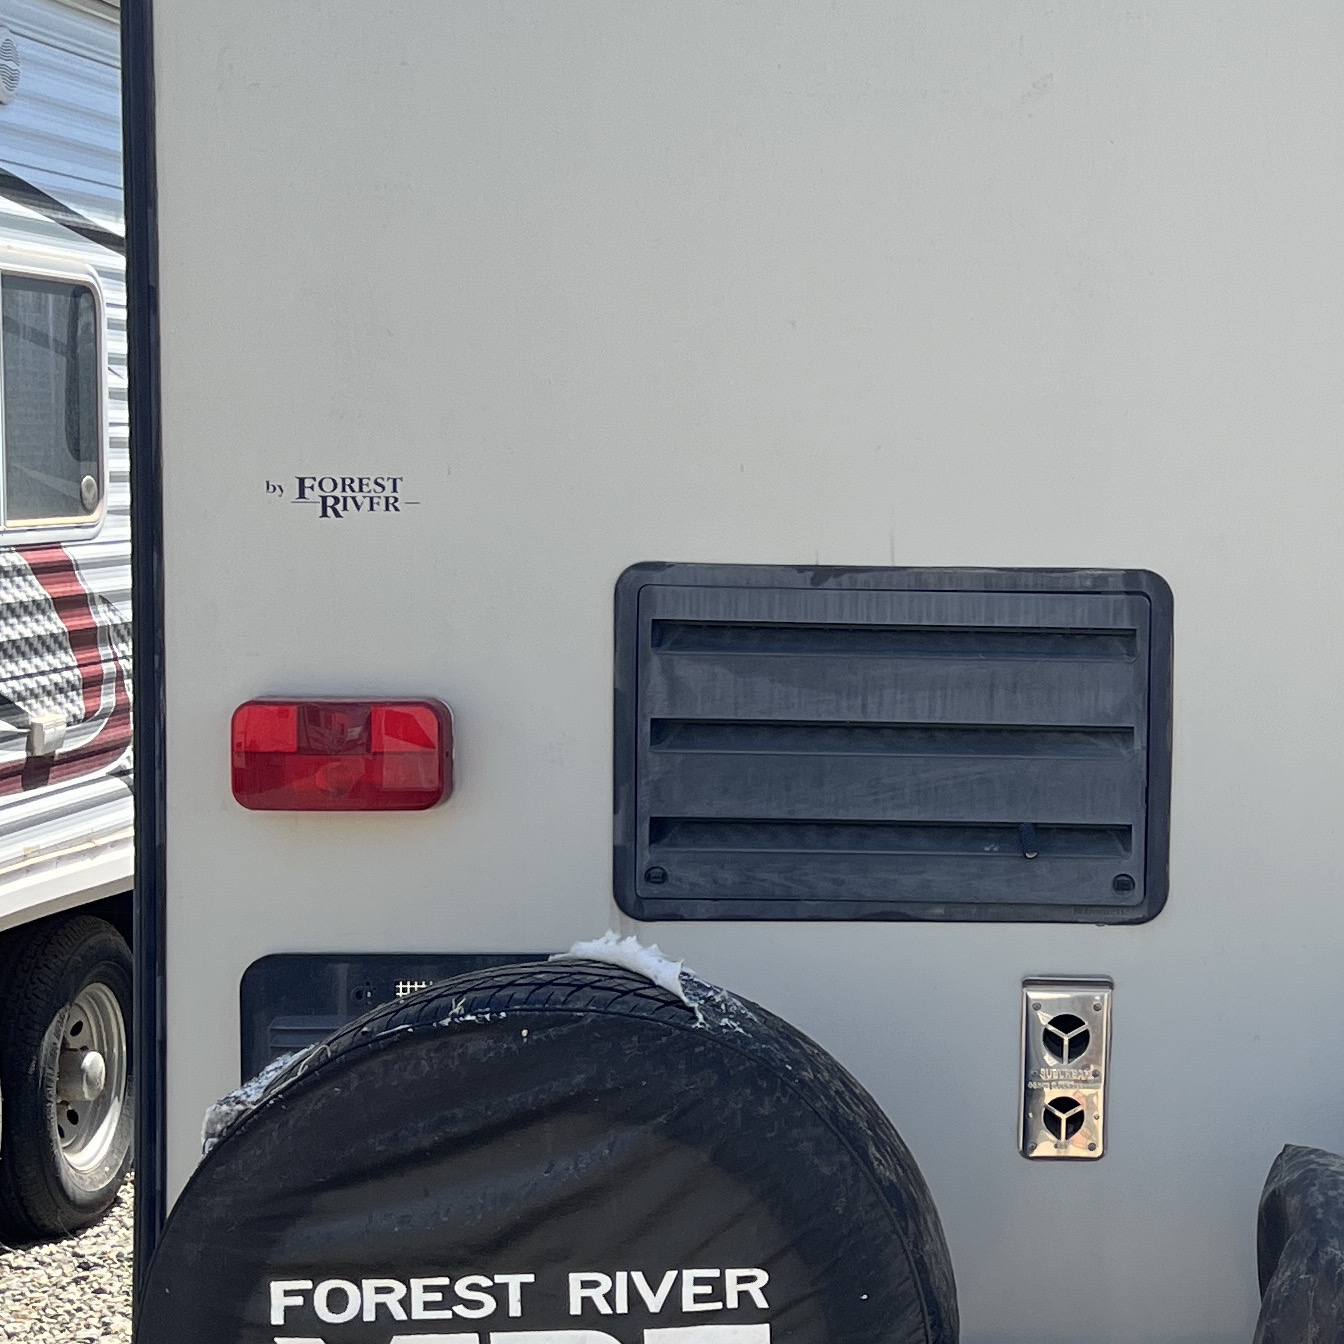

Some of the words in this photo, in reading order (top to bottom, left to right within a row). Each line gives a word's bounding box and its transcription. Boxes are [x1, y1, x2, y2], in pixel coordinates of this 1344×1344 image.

[265, 480, 285, 498] by
[294, 475, 404, 501] FOREST
[269, 1273, 535, 1325] FOREST
[568, 1267, 770, 1316] RIVER
